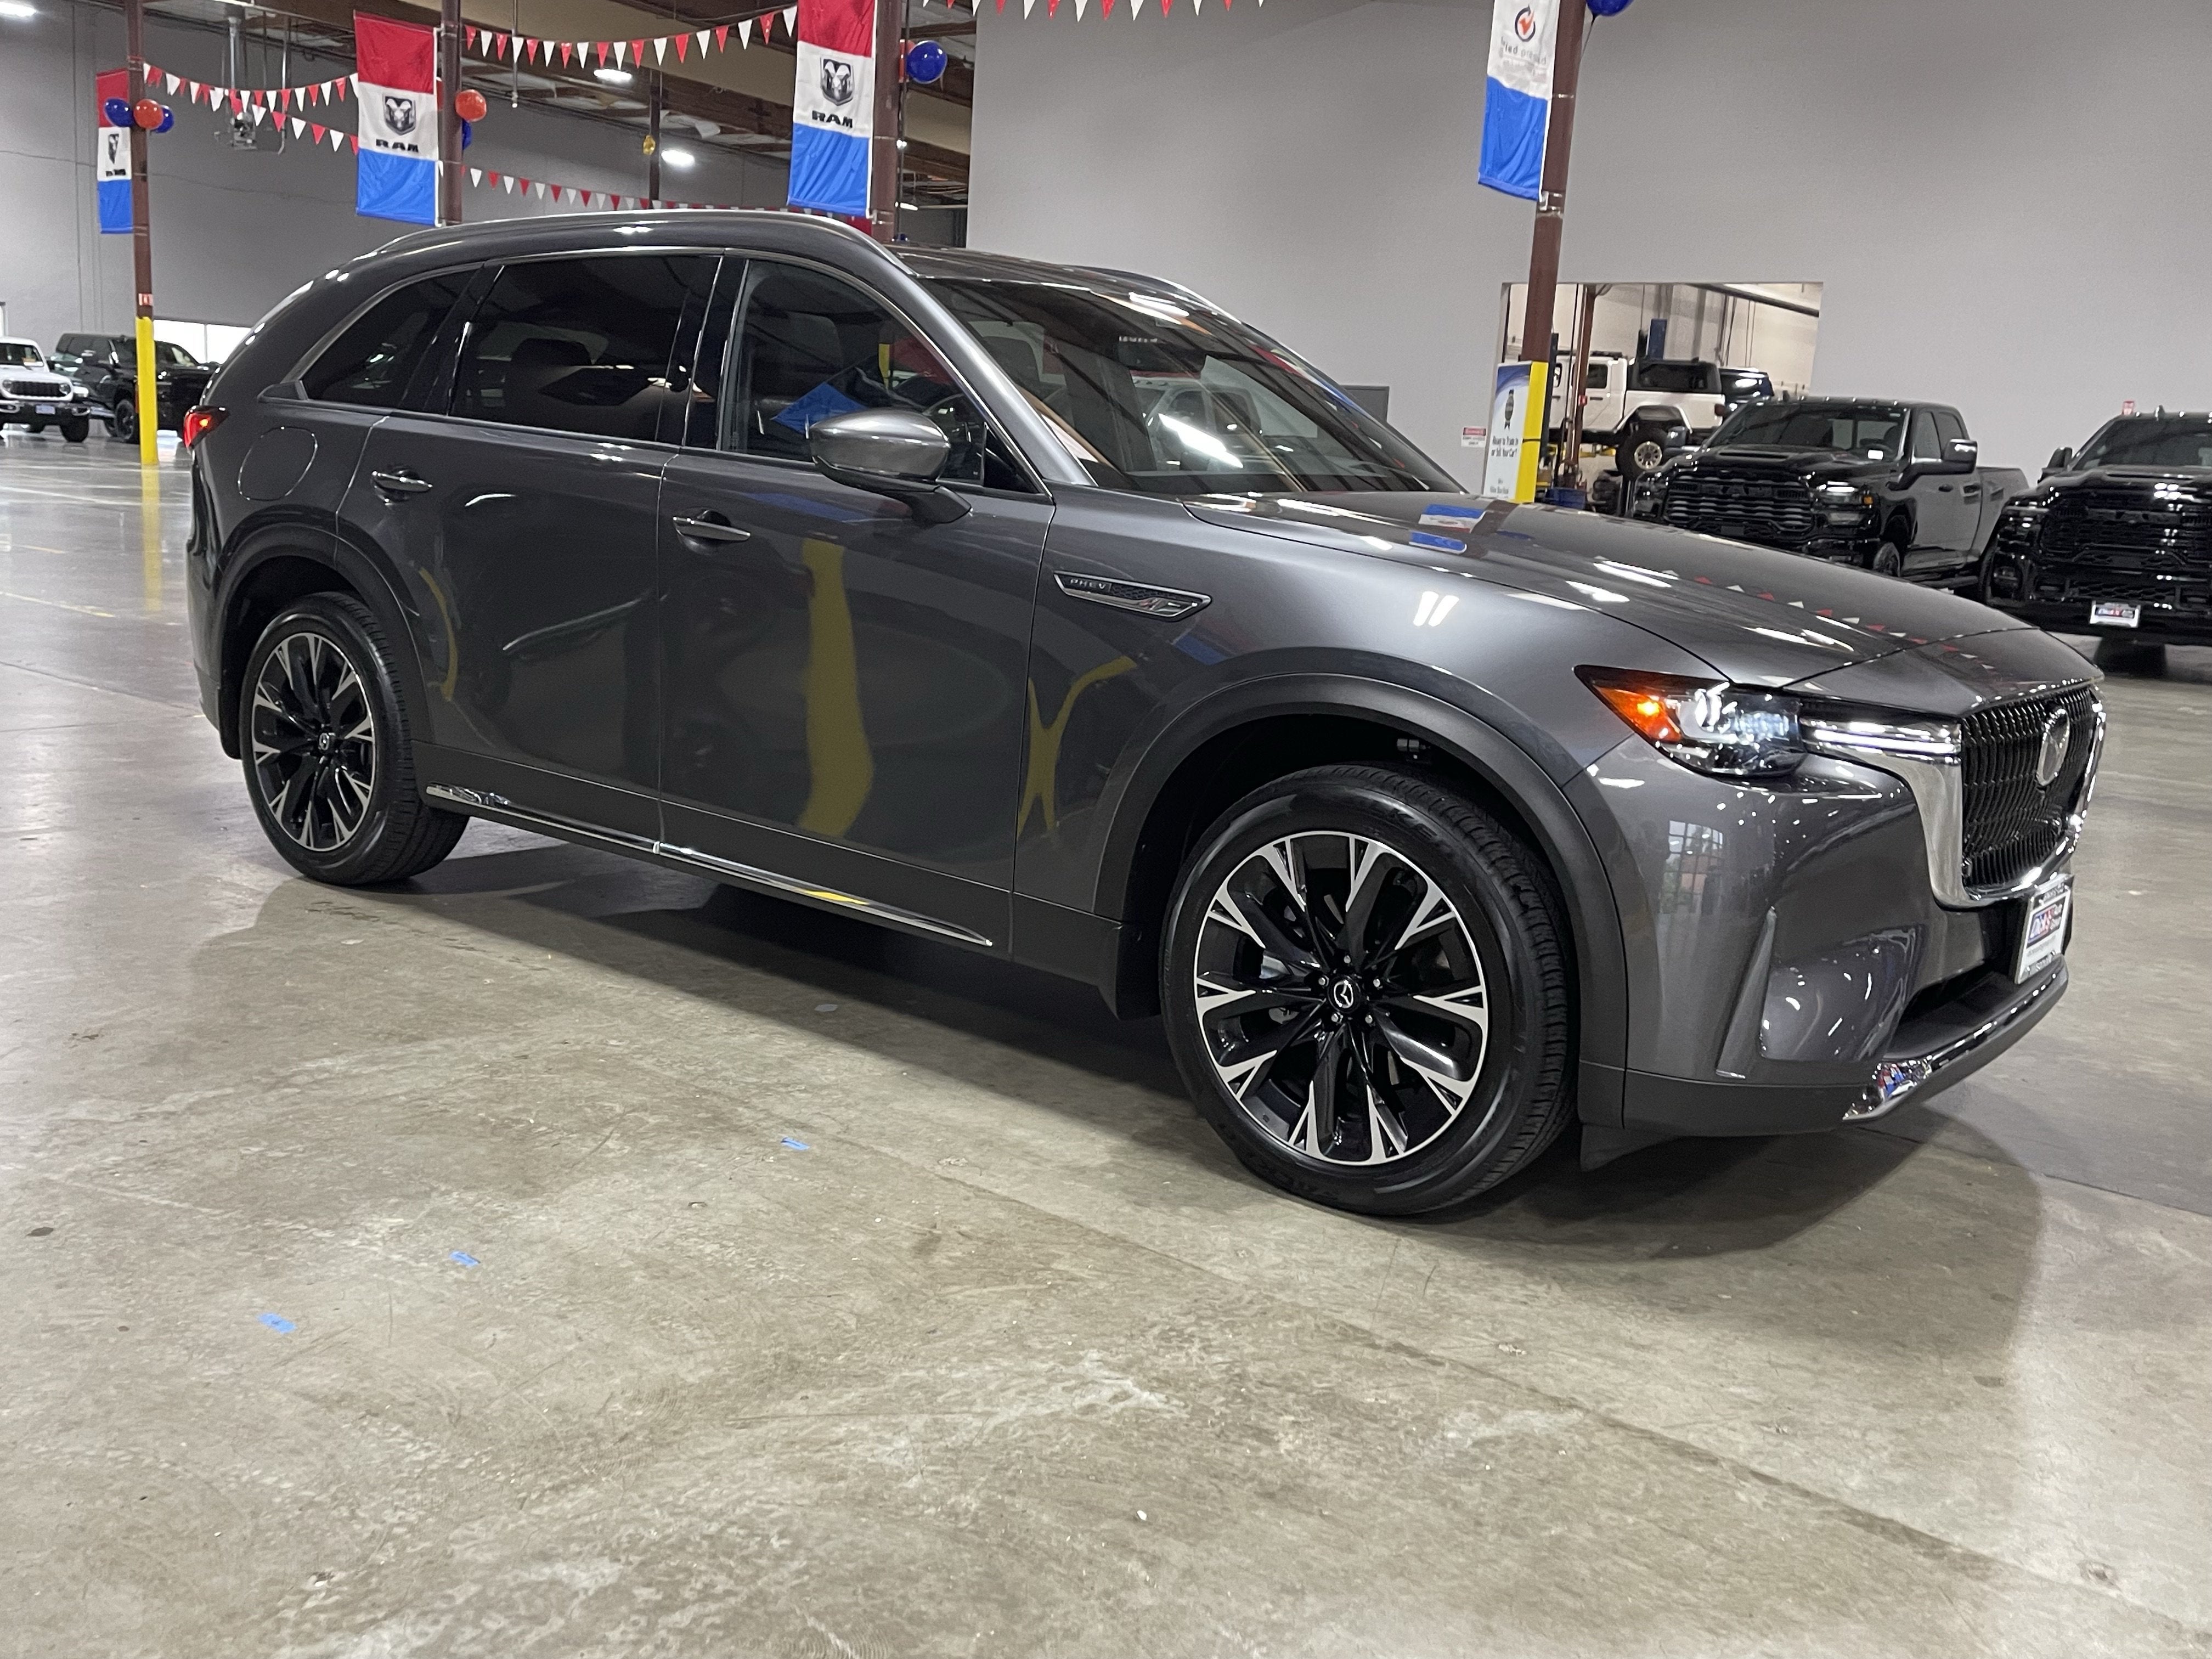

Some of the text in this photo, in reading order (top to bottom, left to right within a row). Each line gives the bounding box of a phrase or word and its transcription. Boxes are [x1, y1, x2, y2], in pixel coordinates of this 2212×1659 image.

[812, 110, 853, 128] RAM
[376, 139, 419, 153] RAM
[1070, 579, 1107, 590] PHEV
